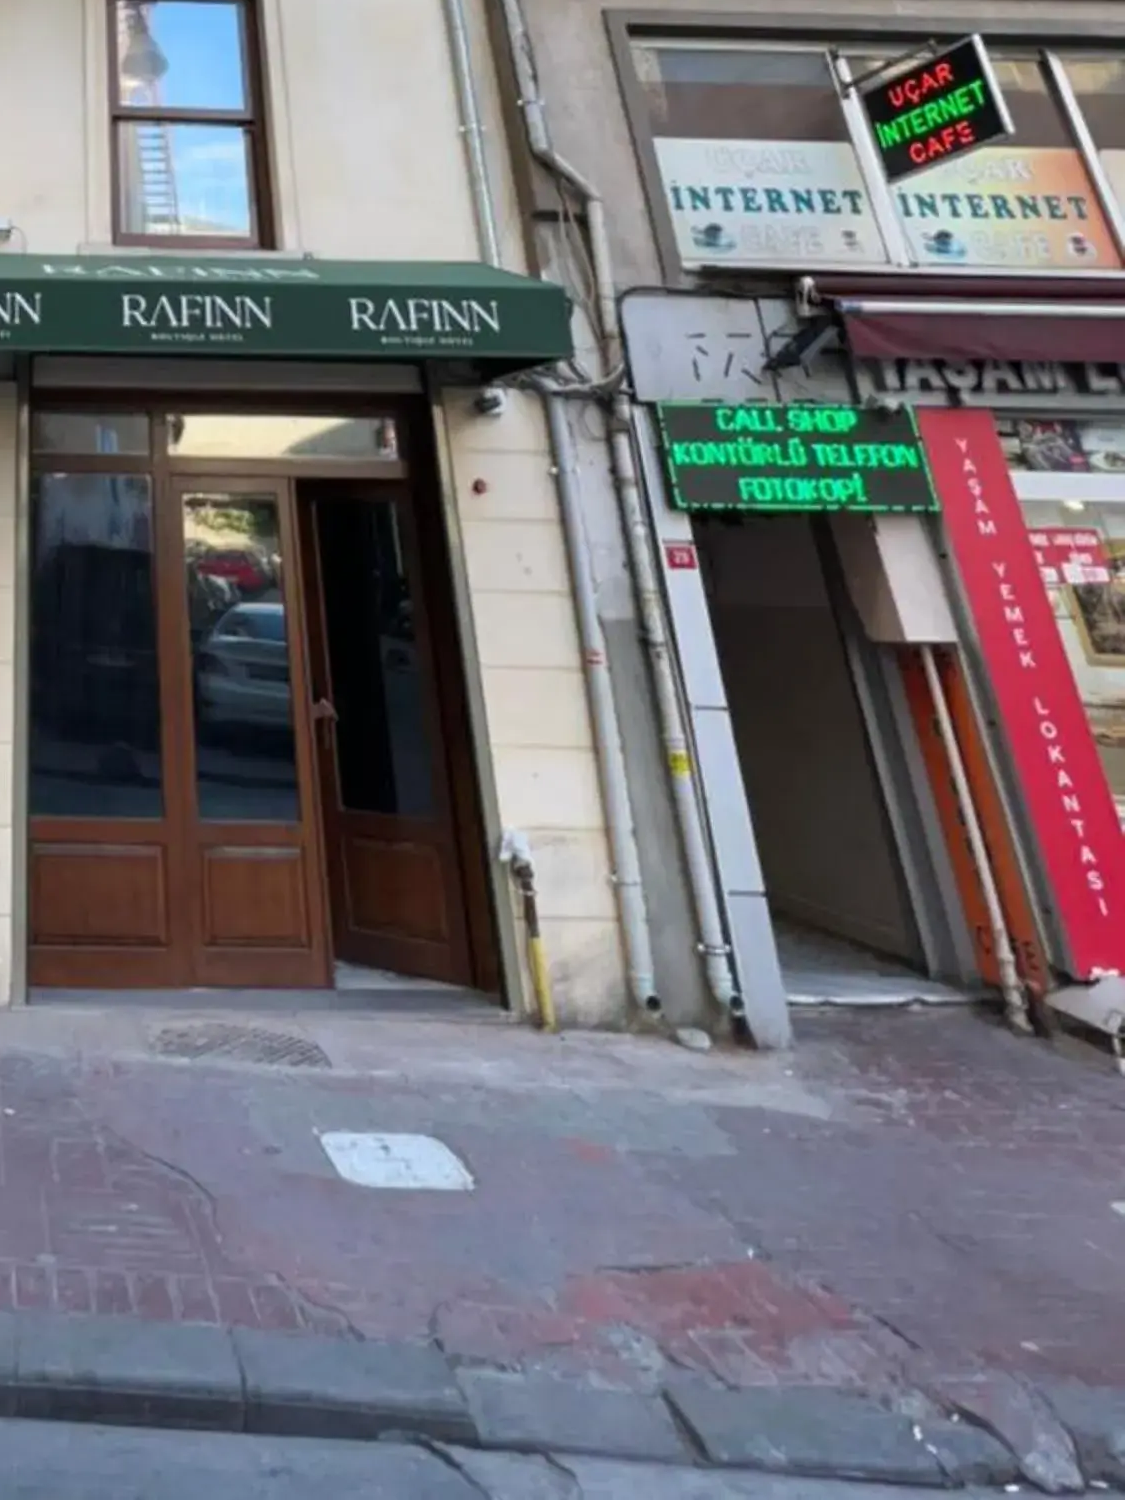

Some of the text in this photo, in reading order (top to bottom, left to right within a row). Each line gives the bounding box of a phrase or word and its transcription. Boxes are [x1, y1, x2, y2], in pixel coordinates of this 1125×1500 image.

[887, 62, 954, 108] UÇAR
[909, 120, 975, 164] CAFE
[121, 293, 274, 328] RAFINN
[348, 297, 501, 333] RAFINN
[715, 408, 858, 432] CALL SHOP
[811, 443, 919, 467] TELEFON
[991, 561, 1036, 669] YEMEK
[1032, 695, 1109, 917] LOKANTASI
